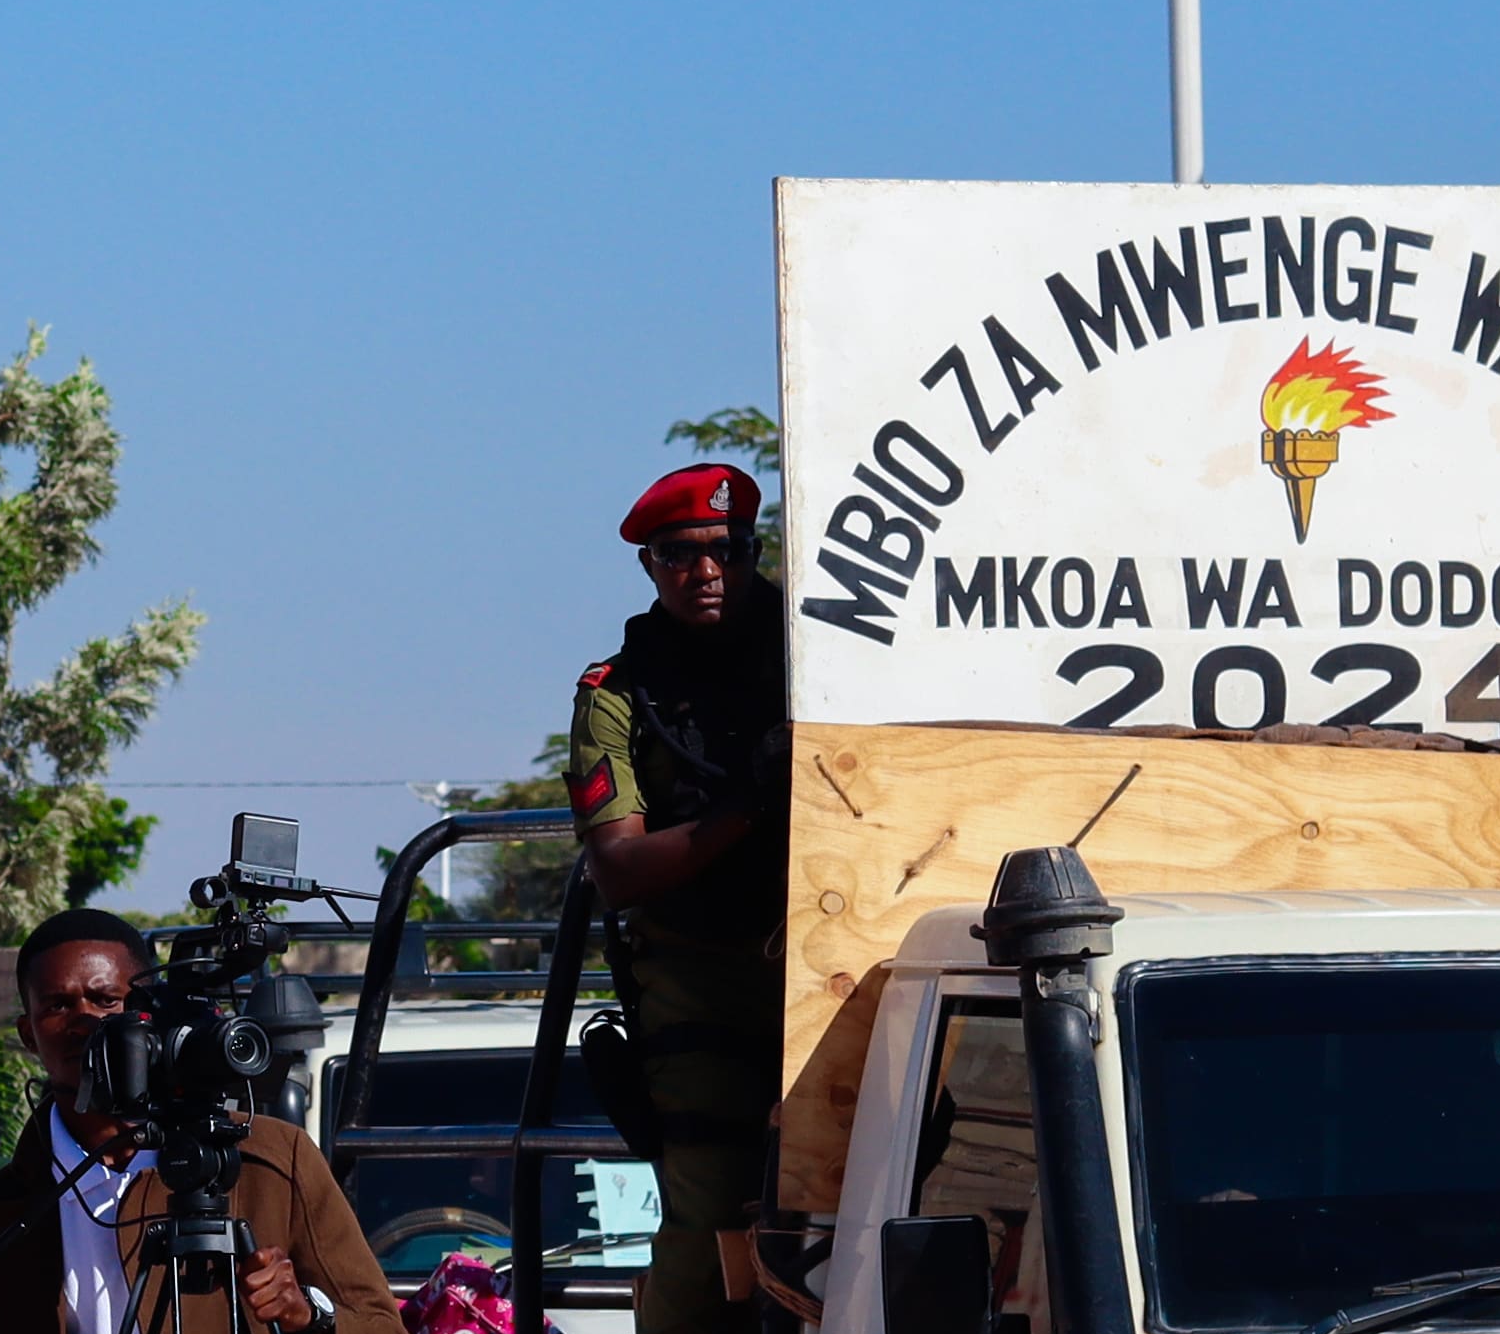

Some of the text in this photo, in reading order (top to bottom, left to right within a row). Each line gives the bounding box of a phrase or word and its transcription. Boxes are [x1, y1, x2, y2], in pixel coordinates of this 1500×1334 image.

[800, 421, 963, 645] MBIO
[921, 316, 1061, 452] ZA
[1046, 217, 1433, 371] MWENGE
[935, 557, 1150, 628] MKOA
[1182, 558, 1300, 628] WA
[641, 1190, 660, 1217] 4
